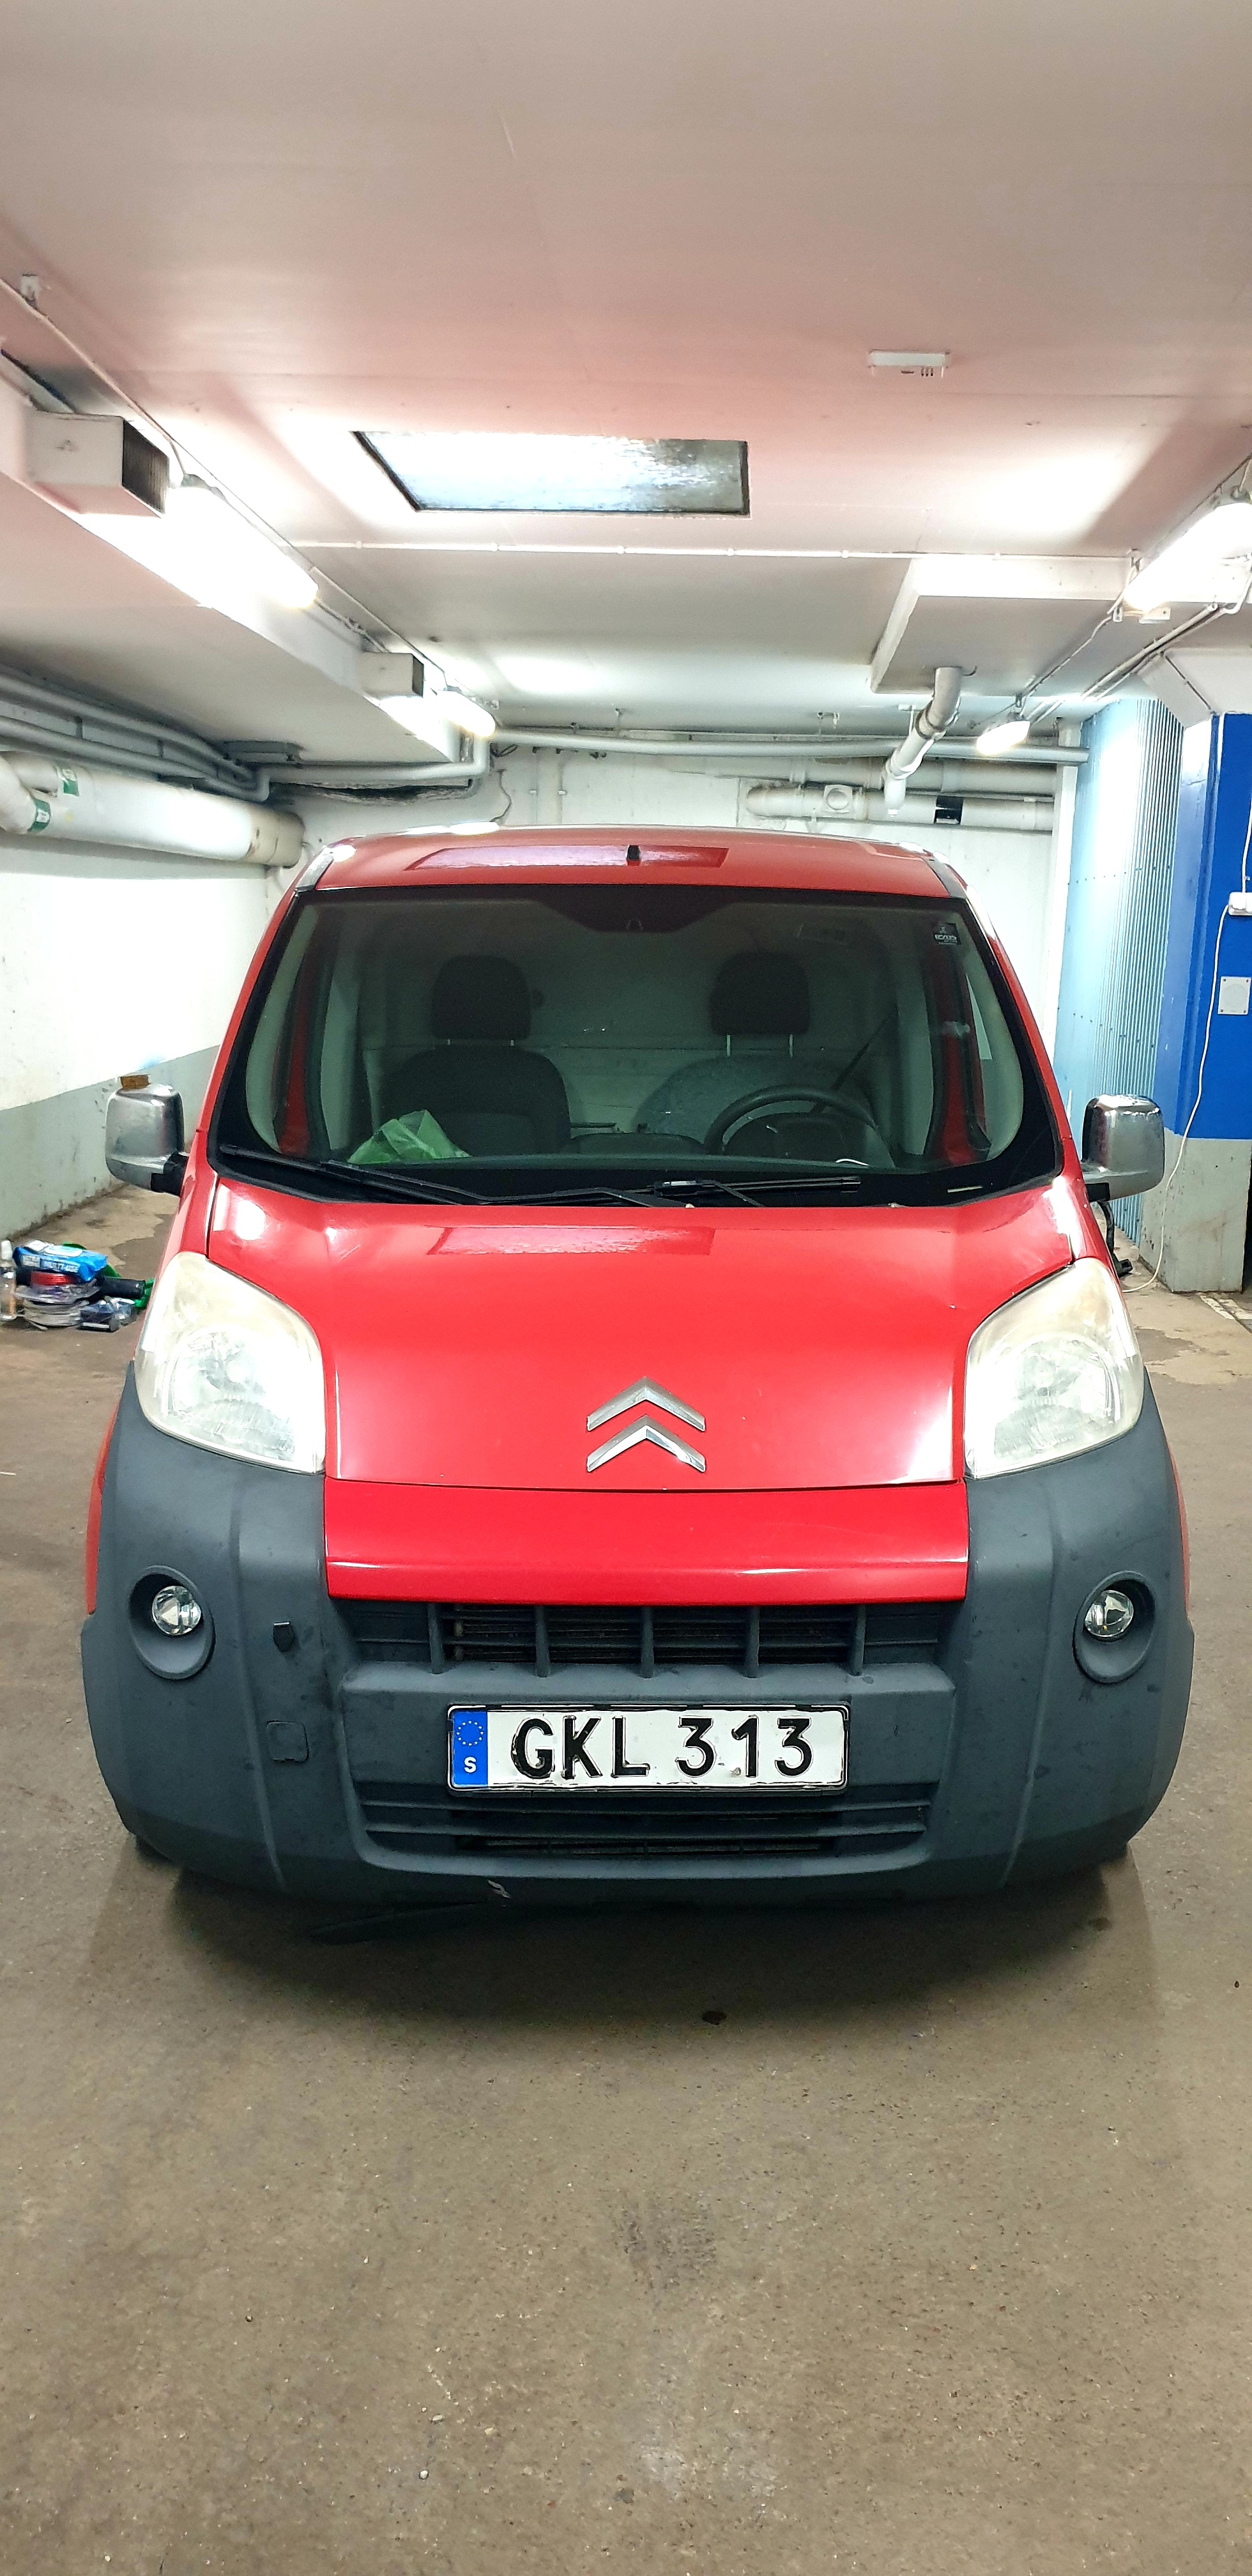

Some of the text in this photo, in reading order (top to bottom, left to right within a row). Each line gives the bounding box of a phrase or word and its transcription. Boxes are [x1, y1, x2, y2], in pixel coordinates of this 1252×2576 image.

[464, 1756, 477, 1773] S
[512, 1716, 813, 1779] GKL 313
